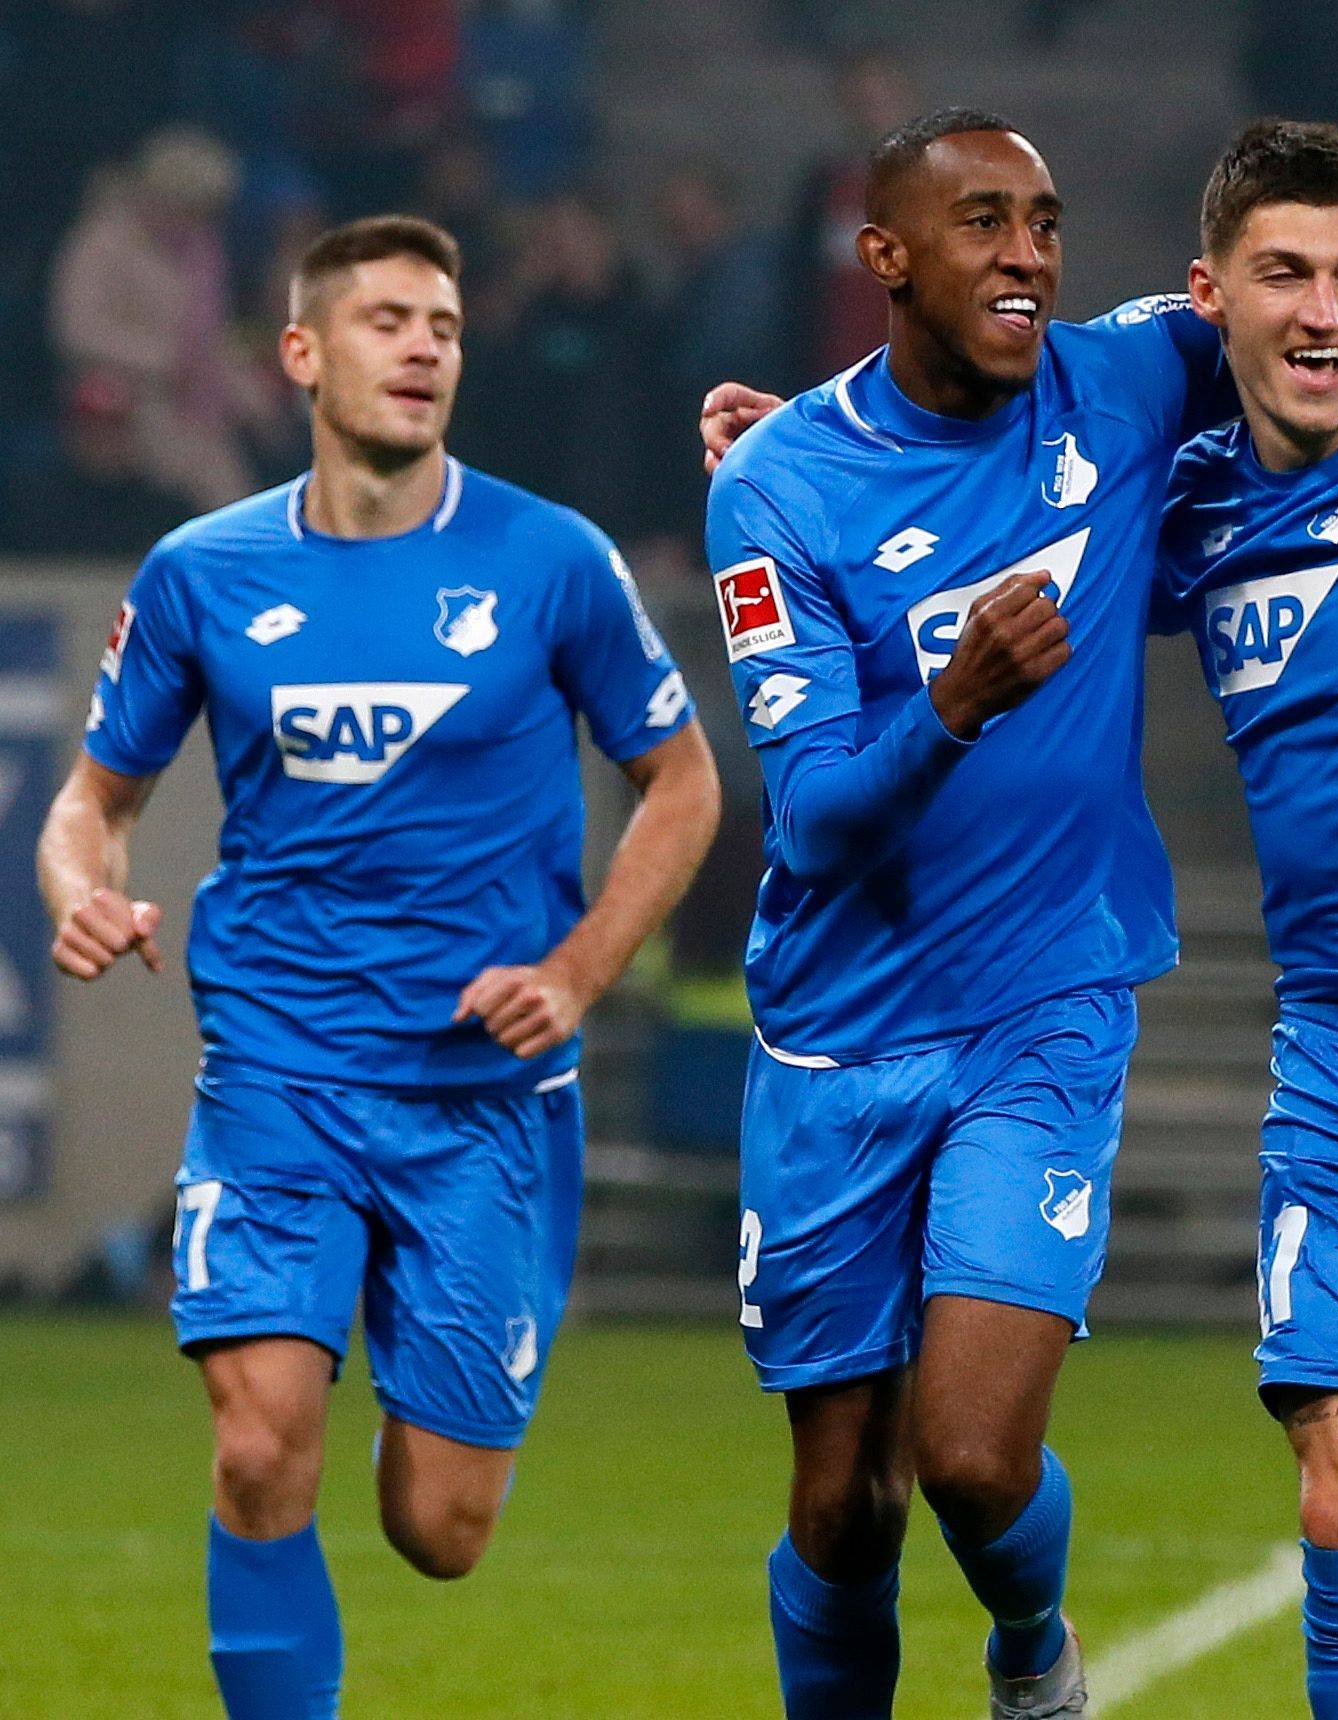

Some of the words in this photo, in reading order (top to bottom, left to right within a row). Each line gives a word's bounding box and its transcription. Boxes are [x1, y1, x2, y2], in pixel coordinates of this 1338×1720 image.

[1209, 595, 1304, 675] SAP
[280, 705, 413, 761] SAP
[172, 1181, 222, 1290] 7
